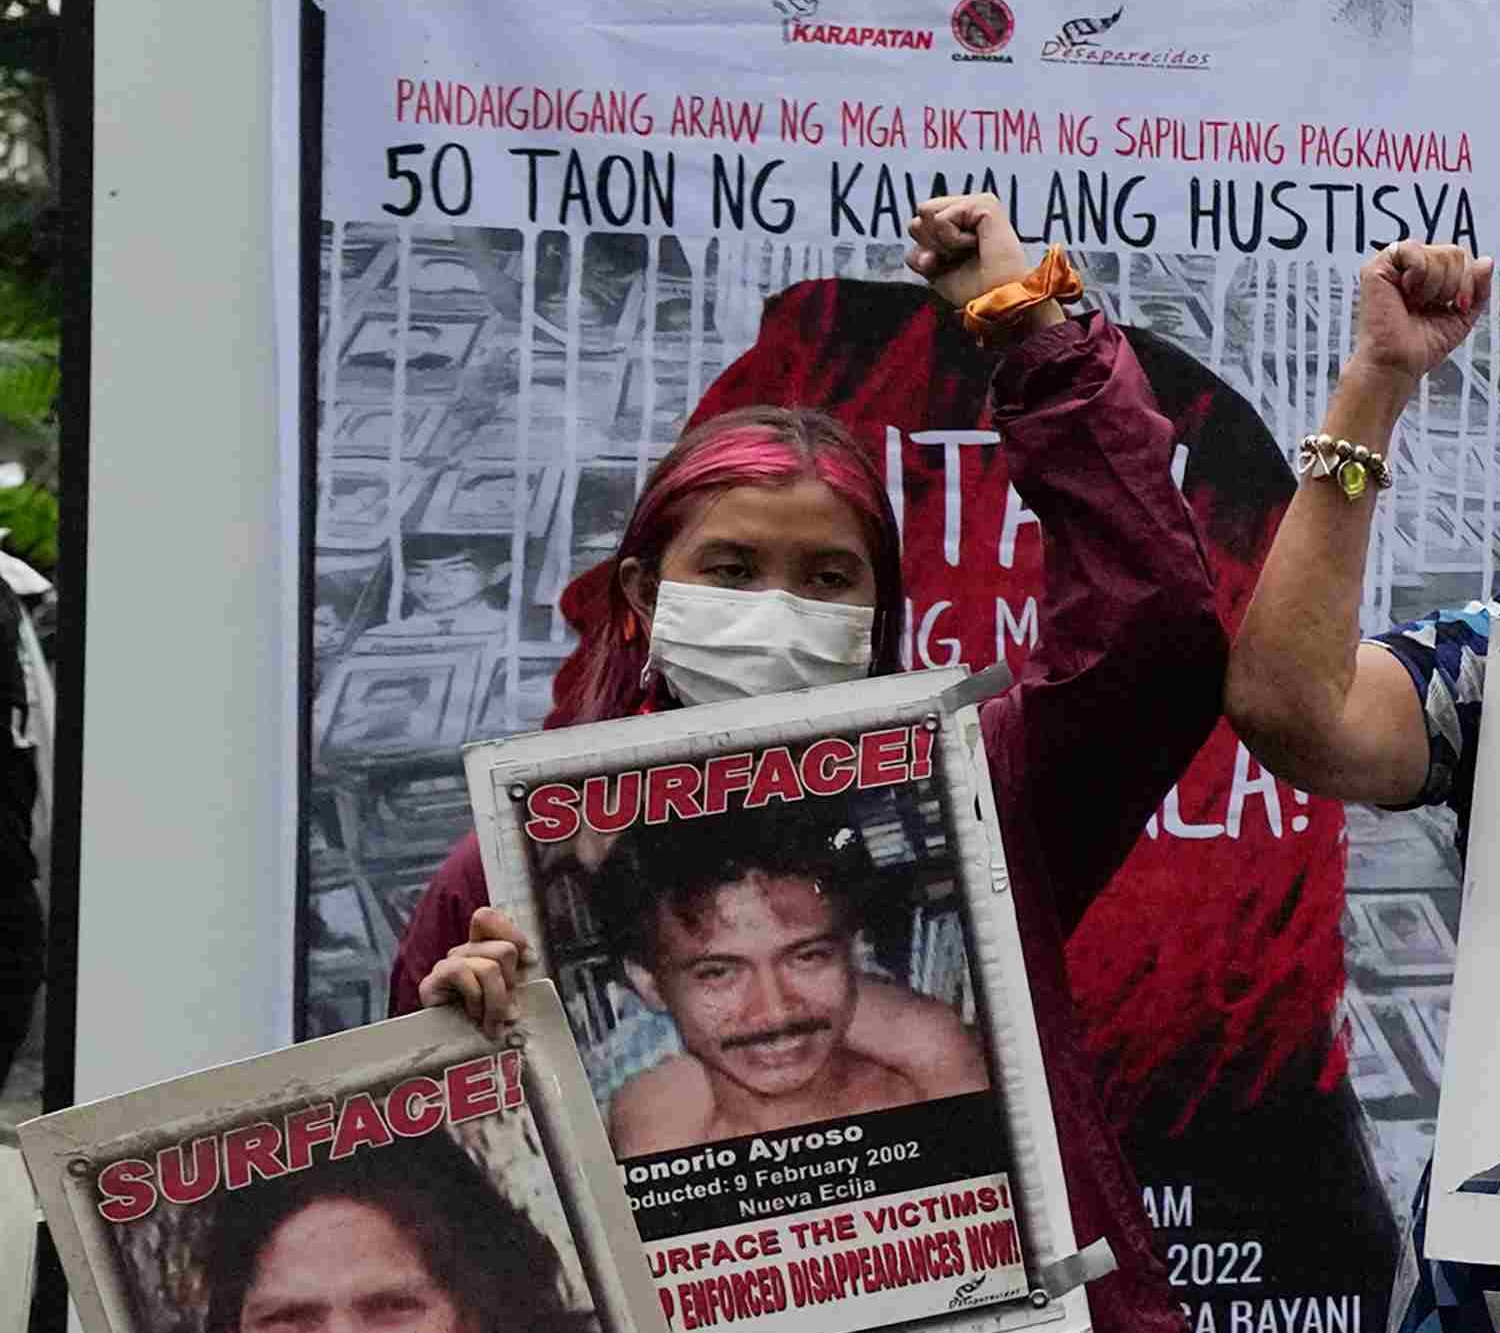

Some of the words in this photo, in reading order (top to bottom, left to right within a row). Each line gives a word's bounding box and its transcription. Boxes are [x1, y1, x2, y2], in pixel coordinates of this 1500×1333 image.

[791, 21, 934, 50] KARAPATAN
[1041, 39, 1211, 66] Desaparecidos
[395, 78, 654, 136] PANDAIGDIGANG
[671, 95, 763, 144] ARAW
[781, 98, 824, 145] NG
[842, 100, 908, 148] MGA
[922, 106, 1042, 155] BIKTIMA
[1059, 113, 1098, 157] NG
[1115, 116, 1286, 166] SAPILITANG
[1300, 123, 1473, 174] PAGKAWALA
[381, 142, 474, 217] 50
[510, 147, 674, 227] TAON
[713, 153, 796, 234] NG
[830, 161, 1157, 249] KALANG
[1190, 174, 1480, 259] HUSTISYA
[524, 723, 936, 844] SURFACE!
[98, 1050, 526, 1223] SURFACE!
[749, 1123, 865, 1164] Ayroso
[734, 1173, 749, 1193] 9
[755, 1154, 859, 1191] February
[867, 1140, 921, 1168] 2002
[738, 1191, 814, 1219] Nueva
[819, 1177, 877, 1208] Ecija
[789, 1214, 858, 1250] THE
[864, 1185, 1011, 1233] VICTIMS!
[680, 1263, 786, 1330] ENFORCED
[788, 1231, 963, 1308] DISAPPEARANCES
[966, 1217, 1021, 1270] NOW!
[1167, 1241, 1264, 1286] 2022
